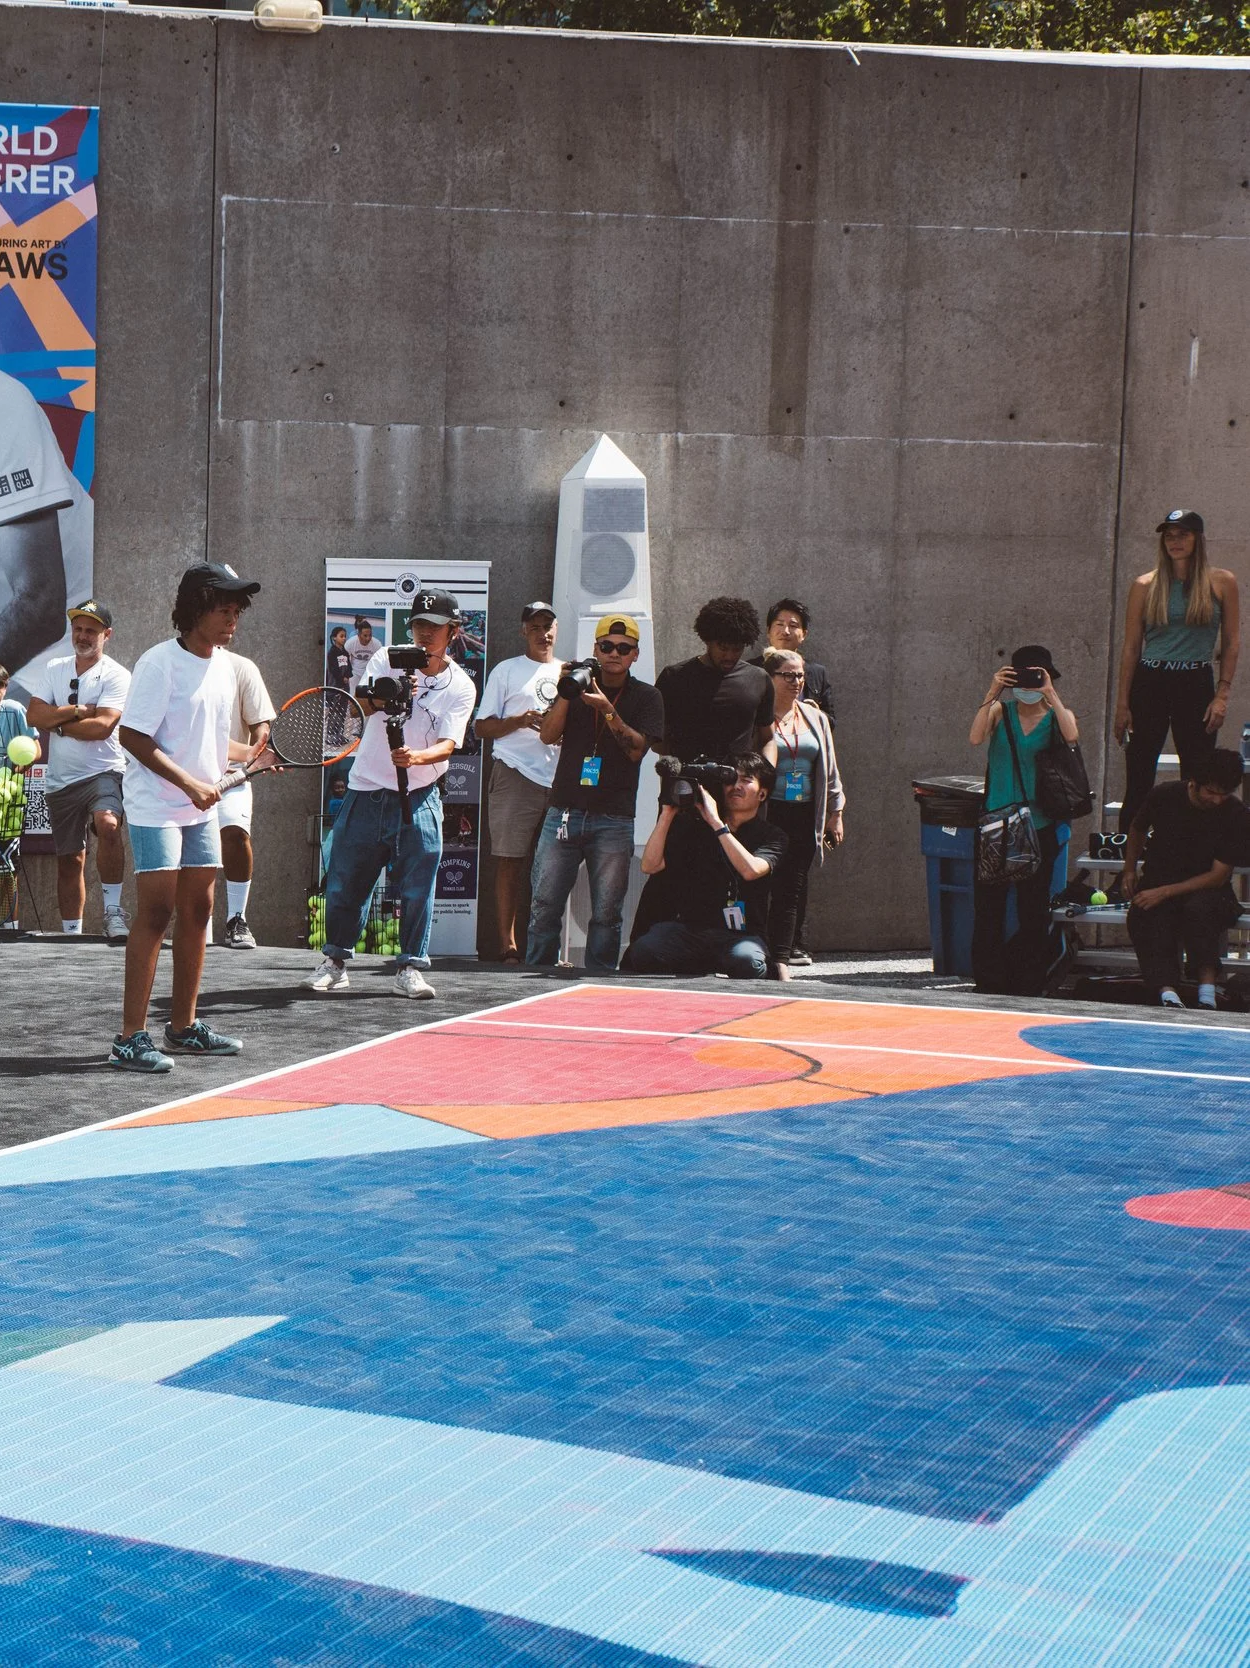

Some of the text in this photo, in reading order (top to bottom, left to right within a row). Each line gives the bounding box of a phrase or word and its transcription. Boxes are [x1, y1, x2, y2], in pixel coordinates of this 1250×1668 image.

[30, 240, 52, 249] ART
[54, 240, 68, 250] BY
[1164, 661, 1199, 670] NIKE
[439, 859, 471, 869] TOMPKINS
